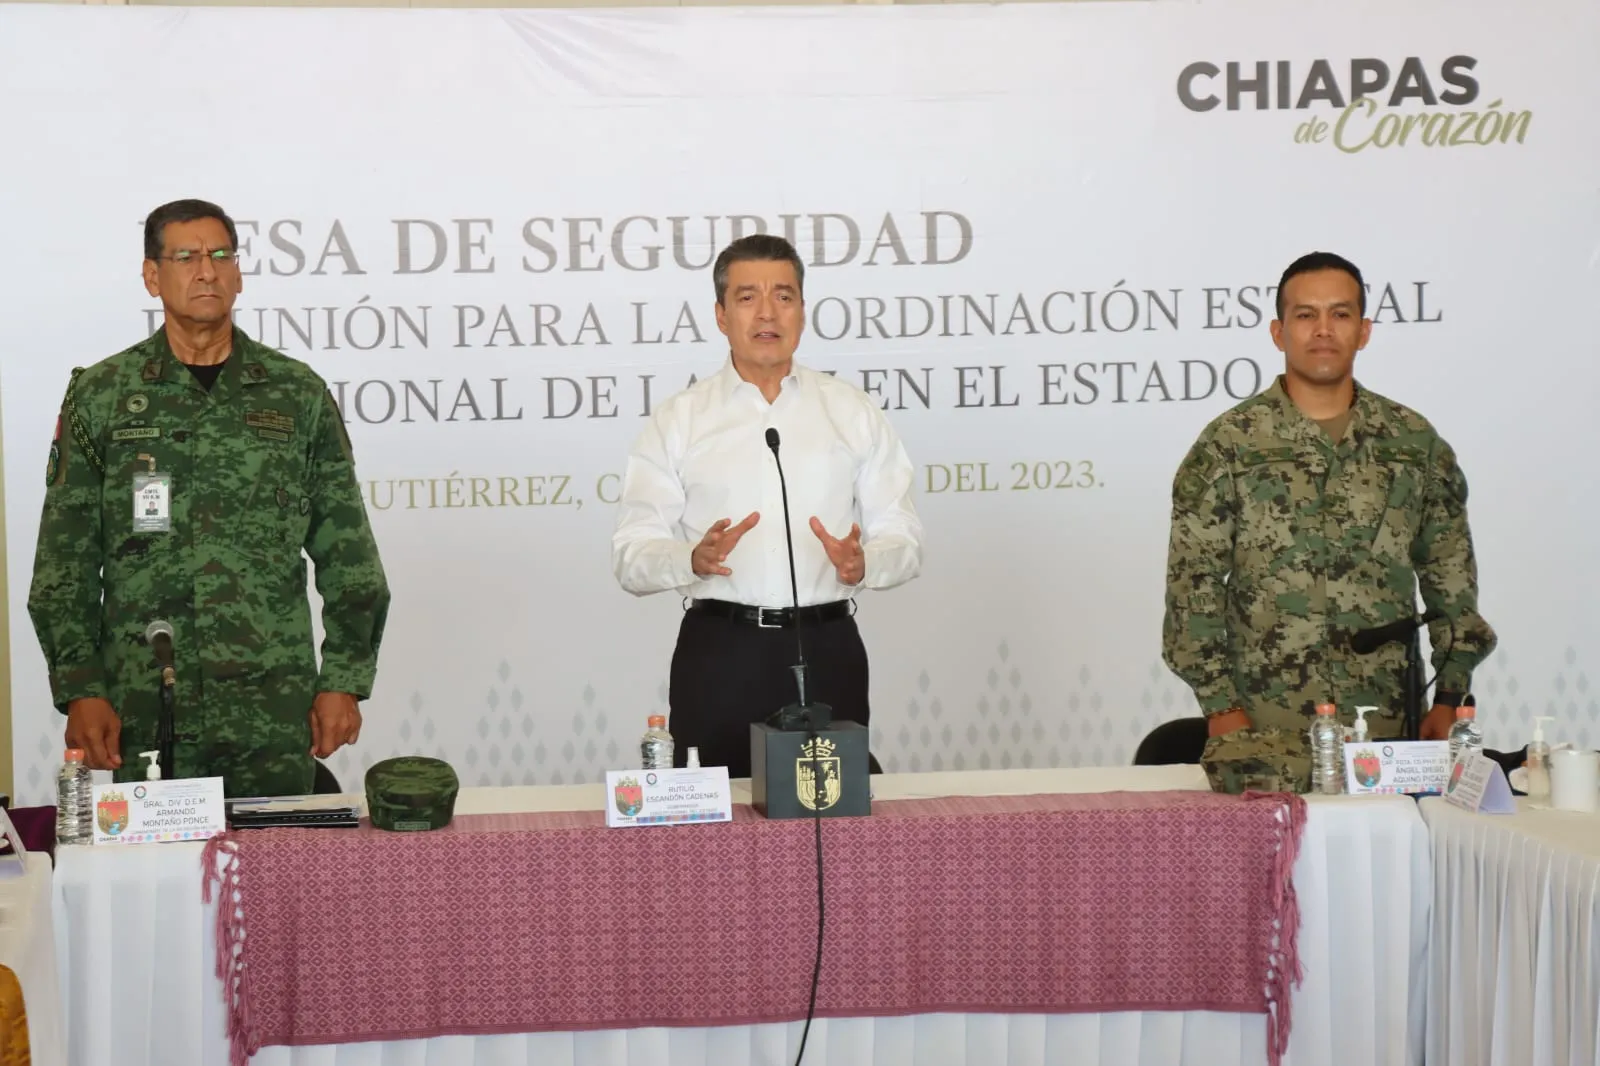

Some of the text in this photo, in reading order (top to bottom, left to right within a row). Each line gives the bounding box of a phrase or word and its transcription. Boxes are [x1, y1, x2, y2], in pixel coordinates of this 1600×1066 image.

[1177, 55, 1480, 112] CHIAPAS
[1293, 98, 1533, 154] de Corazón
[138, 217, 368, 277] ESA
[391, 218, 496, 275] DE
[141, 279, 1444, 351] UNIÓN PARA LA ORDINACIÓN ESAL
[331, 377, 523, 424] IONAL
[541, 375, 619, 420] DE
[857, 367, 935, 411] EN
[953, 365, 1020, 409] EL
[1037, 357, 1262, 407] ESTADO
[365, 470, 583, 511] UTIÉRREZ,
[924, 462, 1000, 494] DEL
[1010, 460, 1105, 491] 2023.
[156, 808, 196, 816] ARMANDO
